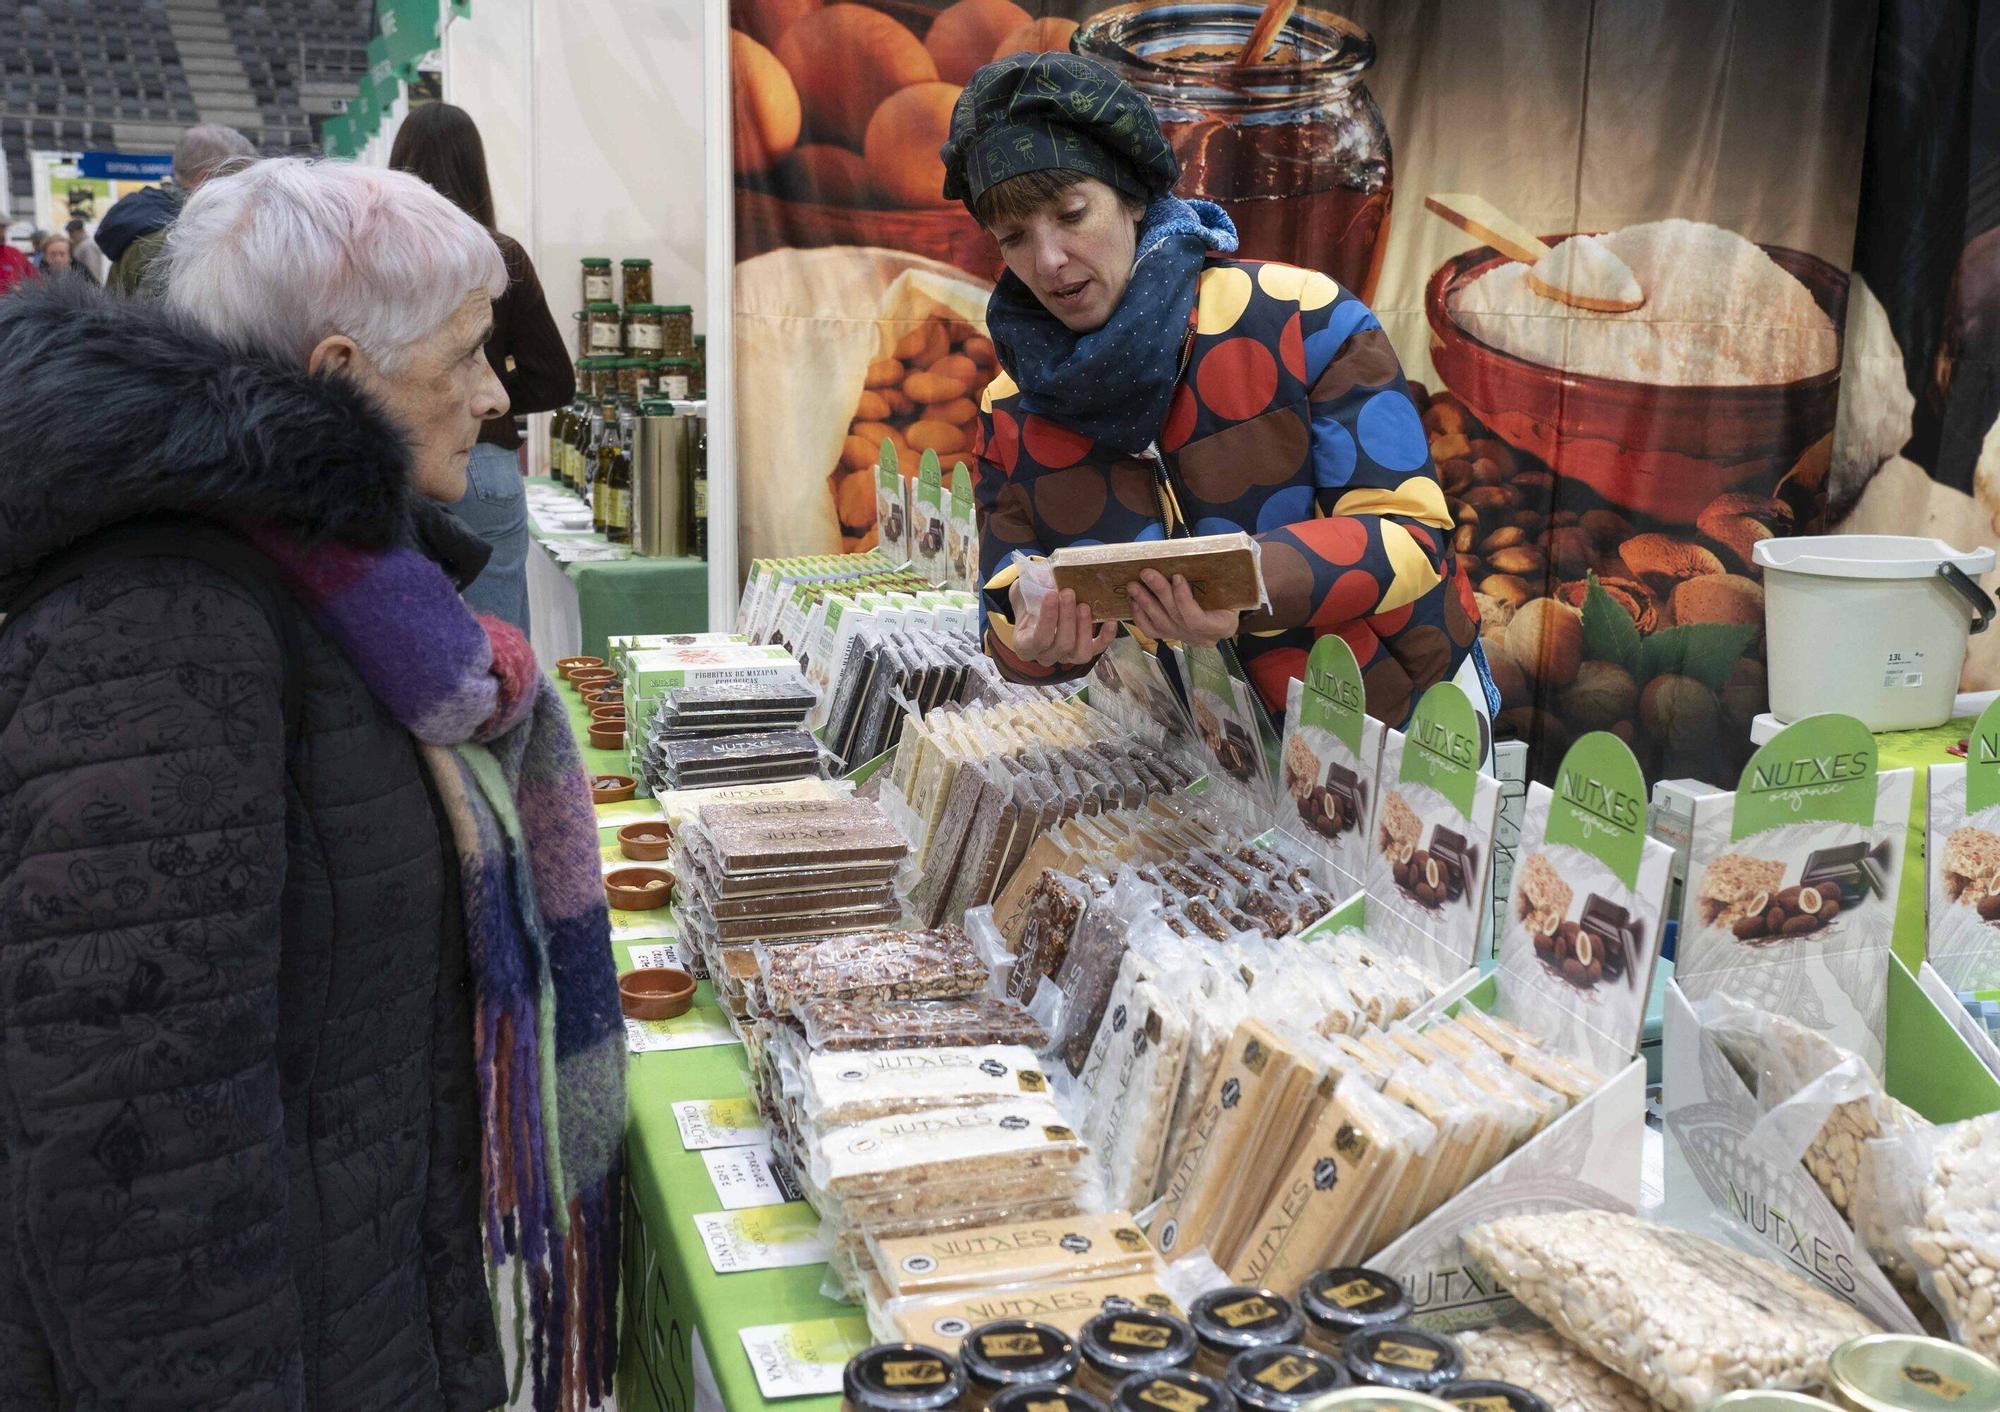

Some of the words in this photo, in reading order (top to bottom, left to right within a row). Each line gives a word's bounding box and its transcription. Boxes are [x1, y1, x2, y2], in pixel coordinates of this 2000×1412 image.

[747, 668, 779, 677] MAZAPAN
[1888, 653, 1902, 662] 13L
[1309, 664, 1360, 709] NUTXES
[712, 738, 783, 753] NUTXES
[1412, 715, 1474, 765] NUTXES
[1419, 750, 1459, 777] organic
[1752, 751, 1869, 790] NUTXES
[711, 786, 785, 799] NUTXES
[1561, 768, 1640, 828] NUTXES
[1769, 782, 1845, 812] organic
[743, 803, 829, 816] NUTXES
[1570, 808, 1621, 839] organic
[759, 829, 846, 841] NUTXES
[816, 939, 921, 967] NUTXES
[872, 1008, 978, 1024] NUTXES
[867, 1054, 973, 1071] NUTXES
[1083, 1028, 1113, 1092] TXES
[881, 1112, 992, 1136] NUTXES
[1165, 1103, 1221, 1206] NUTXES
[705, 1220, 737, 1268] ALICANTE
[931, 1228, 1053, 1256] NUTXES
[1240, 1177, 1310, 1284] NUTXES
[1728, 1180, 1856, 1293] NUTXES
[1402, 1265, 1508, 1307] UTX
[965, 1290, 1094, 1320] NUTXES
